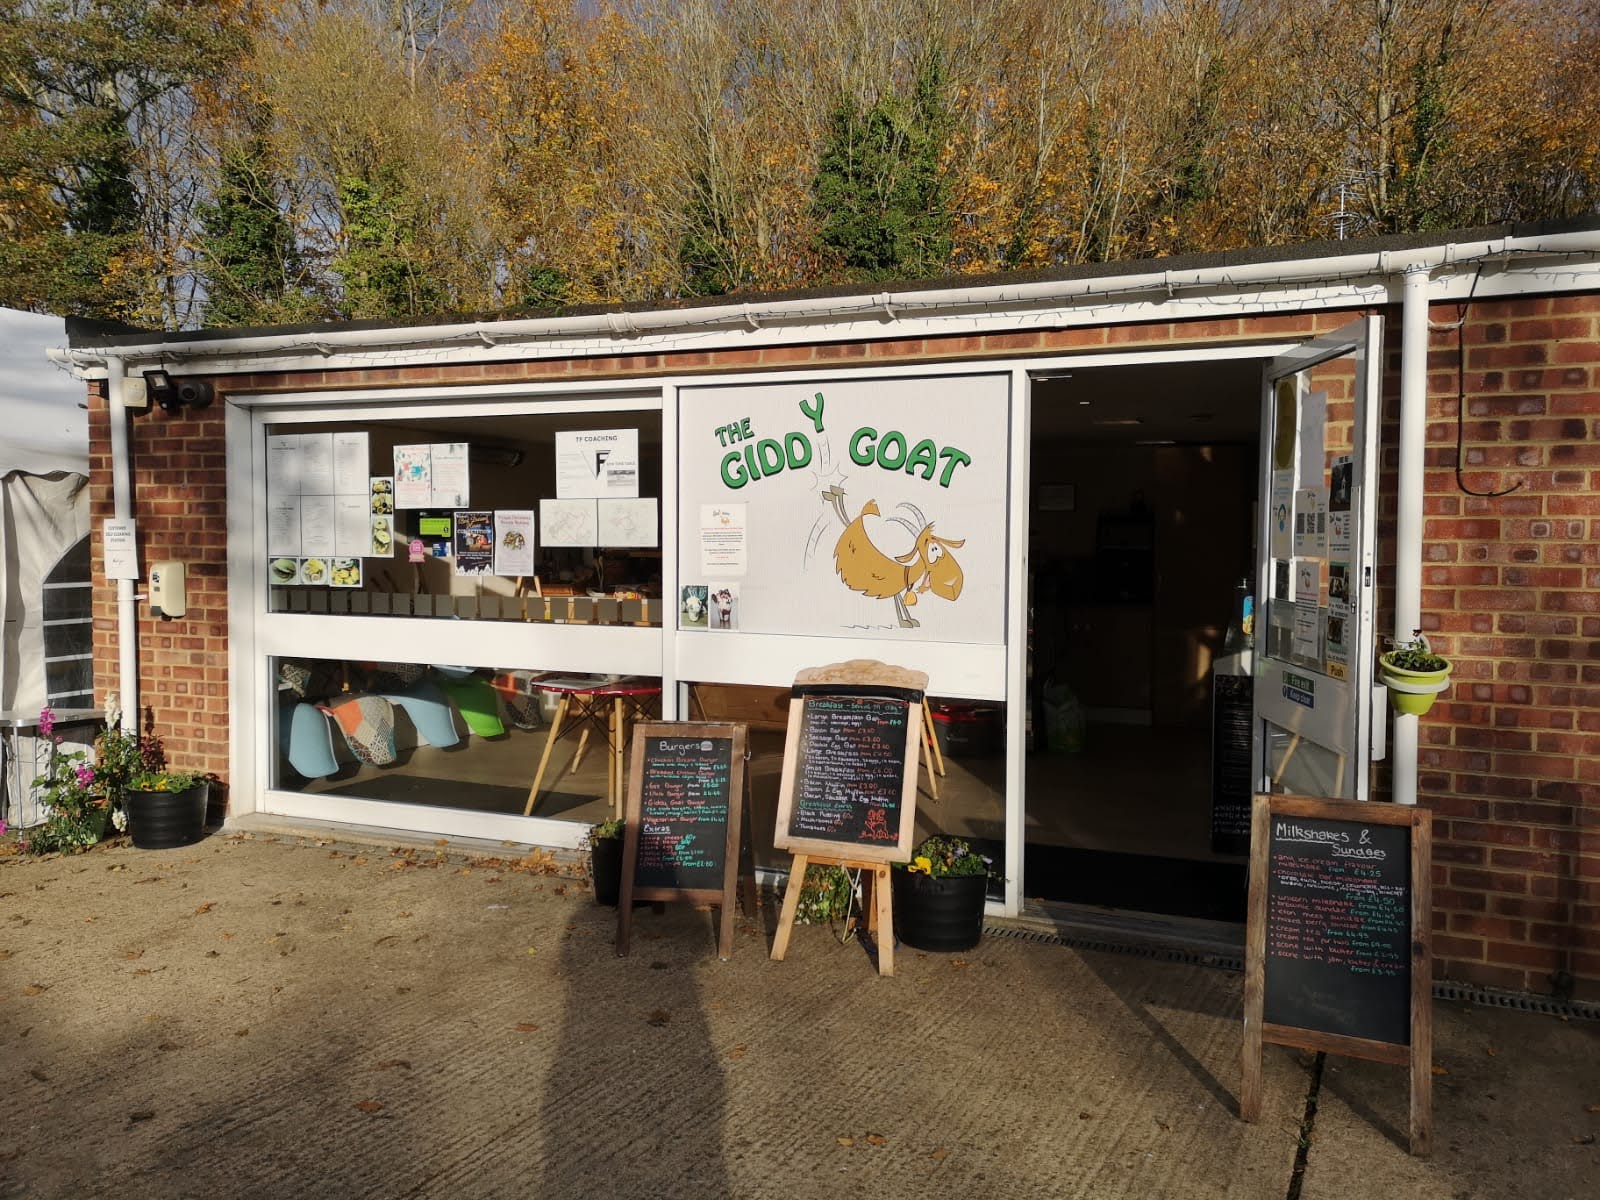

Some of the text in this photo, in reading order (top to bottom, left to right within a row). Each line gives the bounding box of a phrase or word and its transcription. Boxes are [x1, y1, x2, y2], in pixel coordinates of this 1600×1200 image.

[715, 417, 754, 447] THE
[720, 392, 971, 490] GIDDY GOAT
[1331, 664, 1344, 678] Push
[659, 740, 701, 756] Burgers
[800, 809, 816, 817] Black
[644, 824, 671, 833] Extras
[1276, 822, 1373, 845] Milkshakes &
[1332, 844, 1386, 857] Sundaes
[1278, 854, 1296, 864] any
[1312, 858, 1338, 867] cream
[1344, 860, 1376, 870] flavour
[1354, 868, 1382, 878] £4.25
[1345, 892, 1365, 902] from
[1276, 926, 1300, 934] cream
[1327, 928, 1344, 936] from
[1276, 932, 1300, 941] cream
[1351, 940, 1370, 948] from
[1276, 942, 1300, 950] scone
[1304, 944, 1324, 952] with
[1328, 946, 1355, 955] butter
[1278, 950, 1299, 960] scone
[1303, 952, 1324, 960] with
[1350, 965, 1370, 974] from
